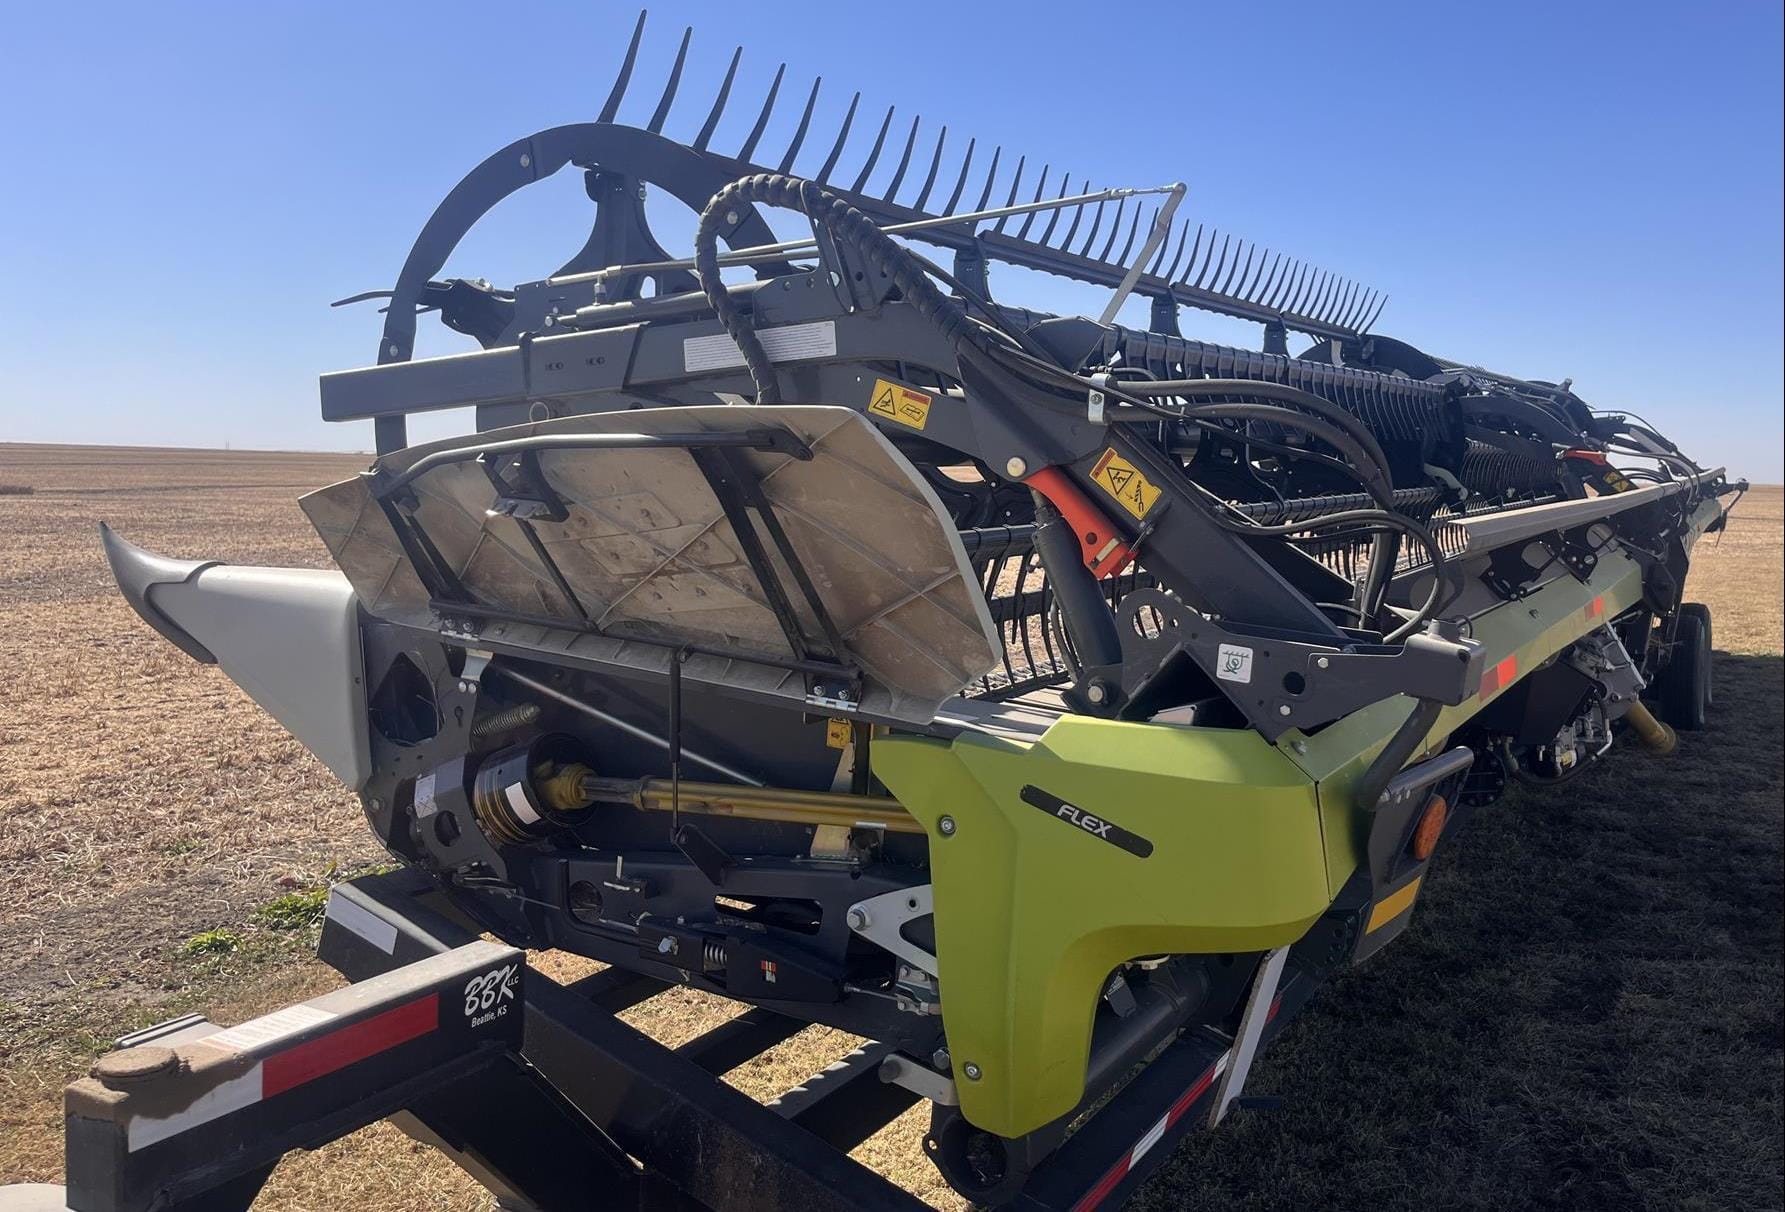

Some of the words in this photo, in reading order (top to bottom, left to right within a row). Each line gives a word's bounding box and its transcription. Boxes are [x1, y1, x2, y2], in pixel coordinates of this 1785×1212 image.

[1057, 804, 1113, 838] FLEX
[464, 963, 518, 1016] BBK
[507, 976, 519, 986] LLC
[471, 1011, 496, 1028] Beattie,
[497, 1004, 508, 1017] KS
